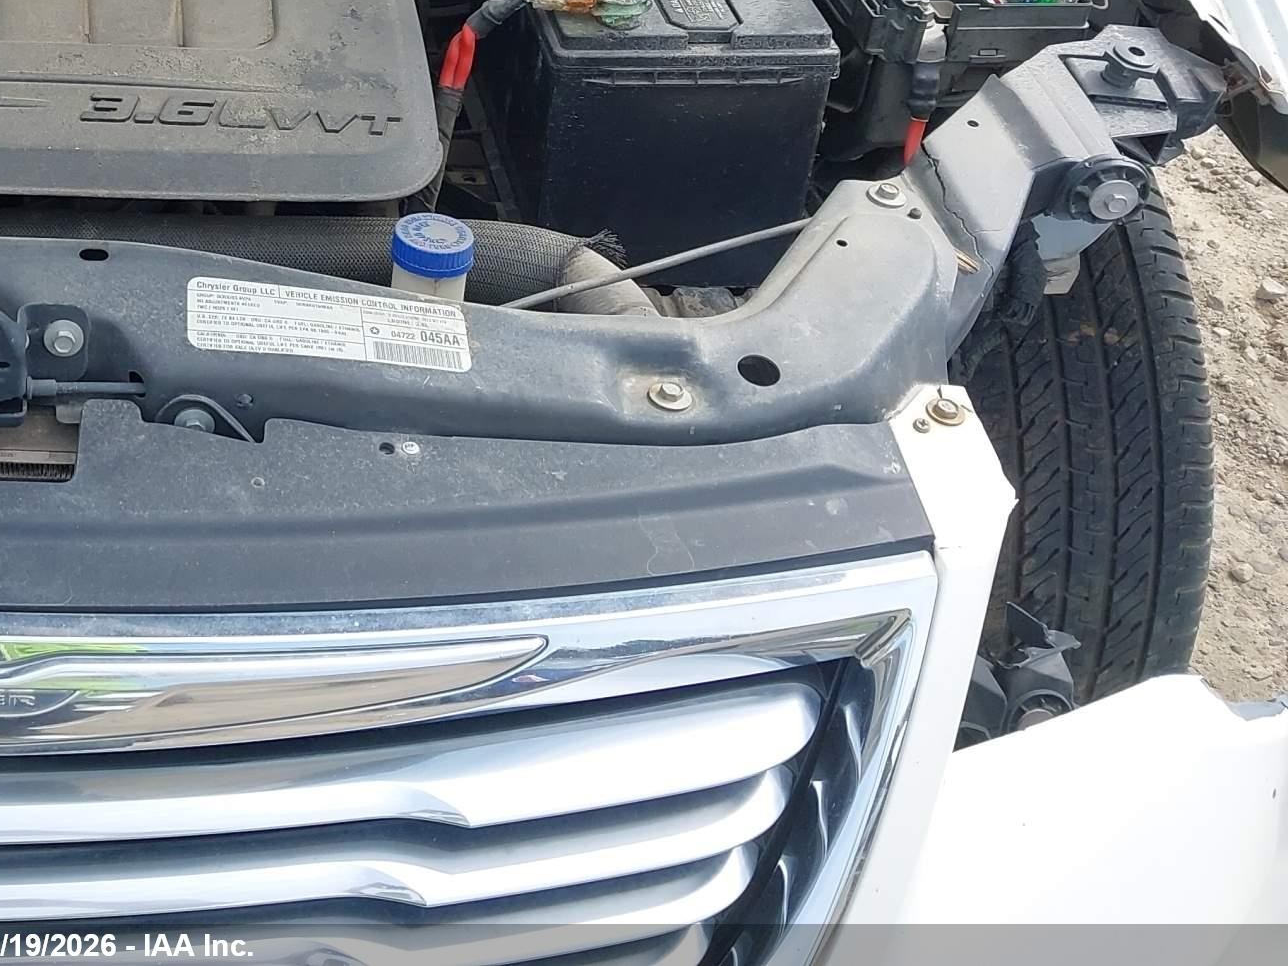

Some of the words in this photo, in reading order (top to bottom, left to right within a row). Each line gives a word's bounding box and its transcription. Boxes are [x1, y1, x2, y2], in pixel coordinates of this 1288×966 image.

[196, 280, 231, 292] Chrysler
[232, 284, 257, 295] Group
[260, 287, 276, 296] LLC
[285, 290, 319, 301] VEHICLE
[320, 293, 359, 305] EMISSION
[361, 299, 398, 311] CONTROL
[400, 304, 457, 318] INFORMATION
[390, 330, 416, 340] 04722
[420, 329, 461, 346] 045AA
